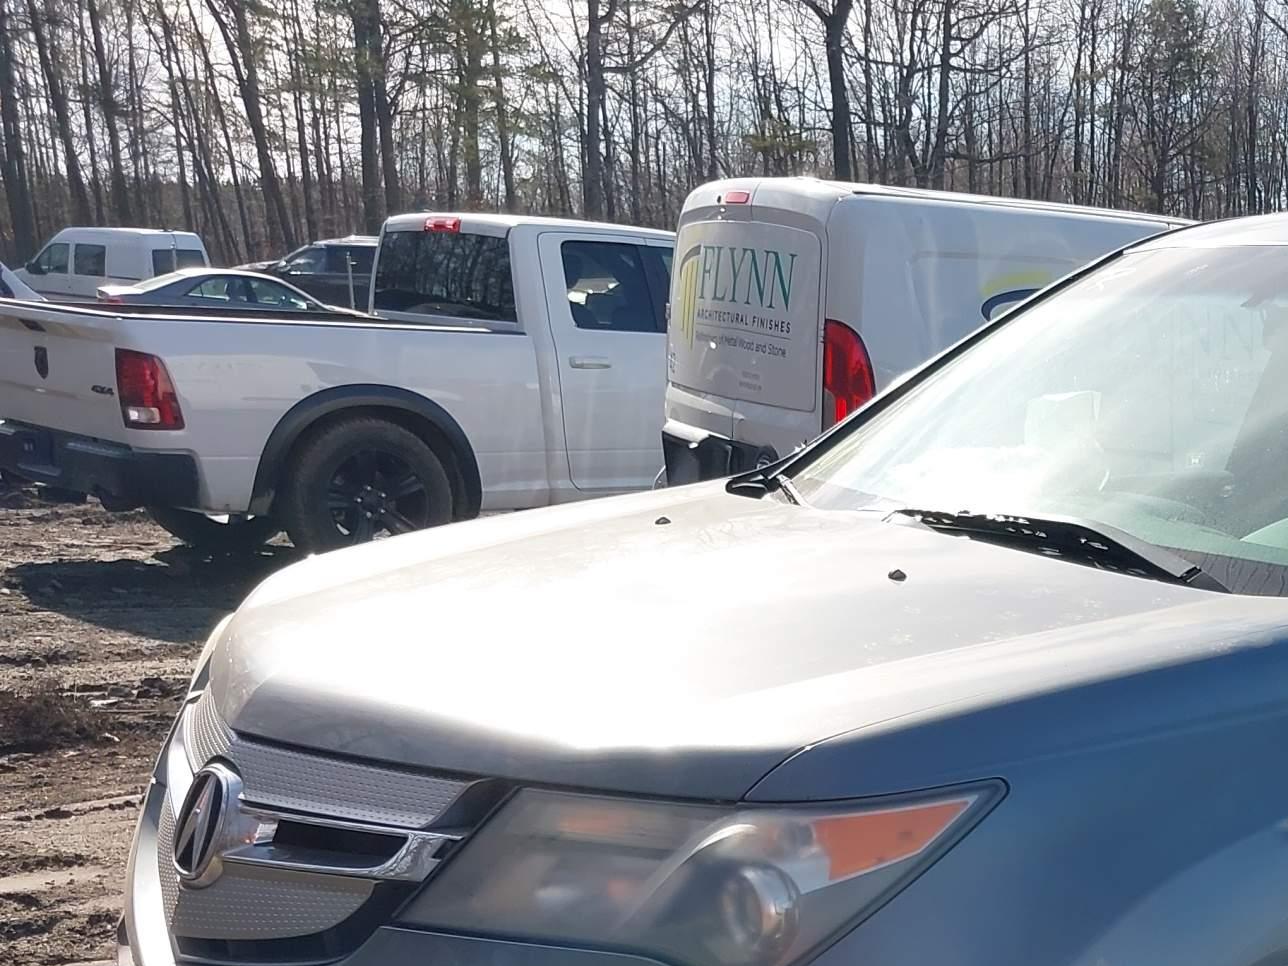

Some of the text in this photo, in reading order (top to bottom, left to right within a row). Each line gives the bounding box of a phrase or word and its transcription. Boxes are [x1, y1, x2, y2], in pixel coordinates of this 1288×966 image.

[698, 245, 798, 312] FLYNN
[697, 308, 791, 334] ARCHITECTURAL FINISHES
